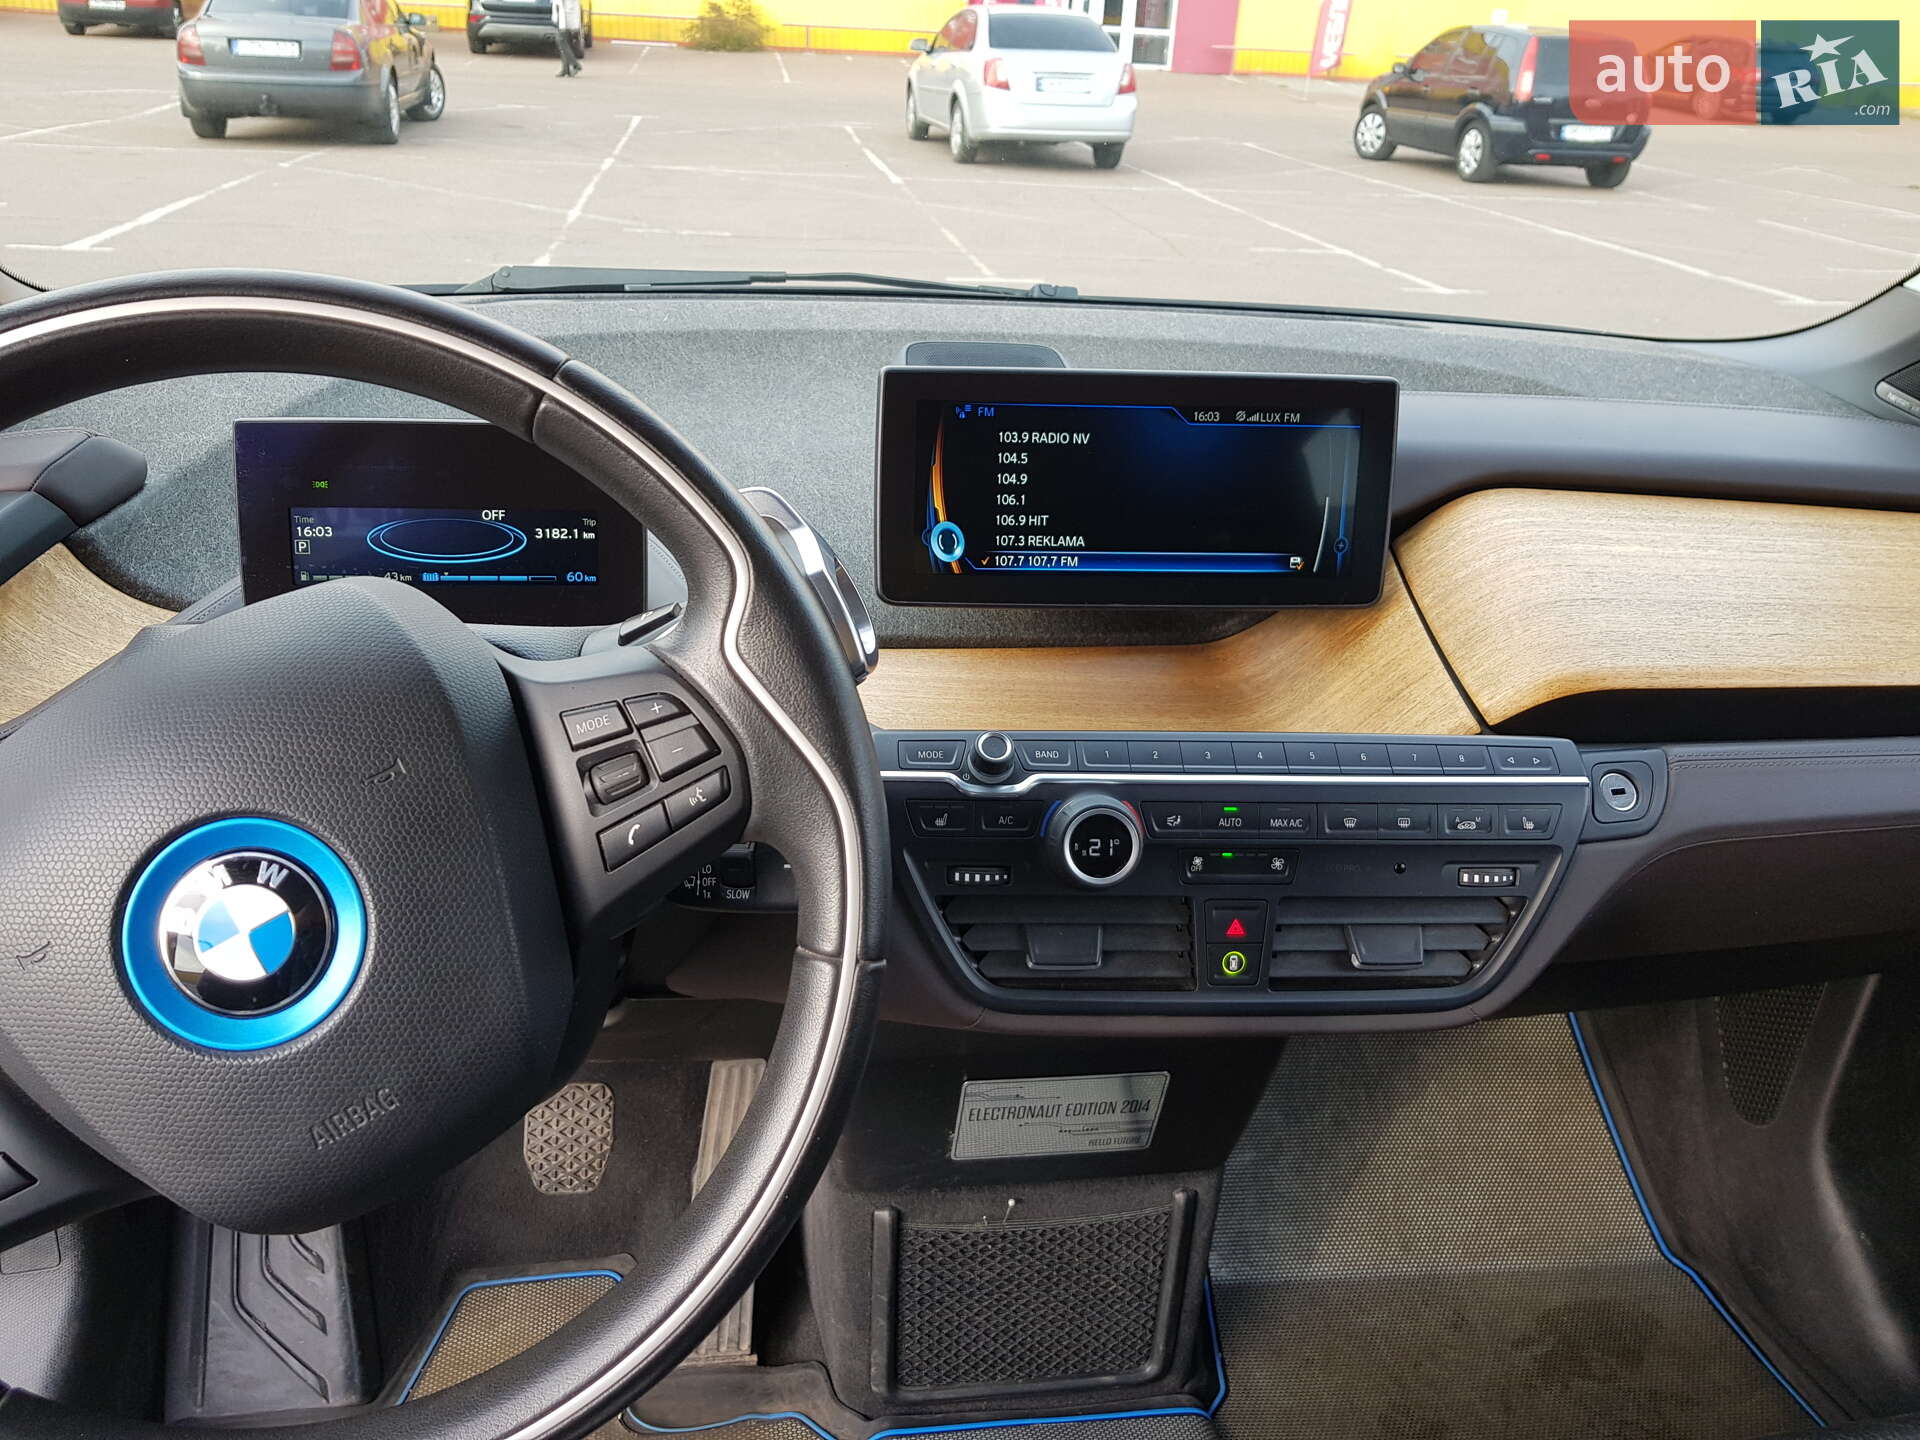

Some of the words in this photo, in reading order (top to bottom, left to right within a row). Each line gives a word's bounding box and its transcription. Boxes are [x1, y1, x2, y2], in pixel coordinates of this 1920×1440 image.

[977, 406, 995, 417] FM
[1193, 411, 1220, 422] 16:03
[1260, 412, 1281, 423] LUX
[1284, 413, 1301, 423] FM
[999, 431, 1029, 444] 103.9
[1031, 432, 1070, 444] RADIO
[1072, 433, 1091, 445] NV
[998, 452, 1028, 464] 104.5
[997, 473, 1028, 485] 104.9
[996, 494, 1026, 506] 106.1
[294, 515, 315, 524] Time
[482, 509, 506, 521] OFF
[996, 514, 1026, 526] 106.9
[1028, 514, 1049, 526] HIT
[582, 518, 597, 527] Trip
[296, 526, 333, 537] 16:03
[535, 528, 579, 539] 3182.1
[583, 531, 596, 540] km
[995, 535, 1025, 547] 107.3
[1027, 535, 1086, 547] REKLAMA
[298, 541, 308, 553] P
[995, 555, 1025, 567] 107.7
[1060, 556, 1079, 567] FM
[400, 574, 413, 582] km
[567, 571, 583, 583] 60
[585, 574, 597, 583] km
[575, 713, 611, 736] MODE
[918, 750, 945, 760] MODE
[1034, 750, 1060, 760] BAND
[1104, 750, 1110, 759] 1
[1151, 750, 1159, 759] 2
[1204, 751, 1212, 760] 3
[1256, 751, 1264, 760] 4
[1308, 751, 1316, 760] 5
[1359, 752, 1368, 761] 6
[1410, 753, 1418, 762] 7
[1458, 753, 1466, 763] 8
[998, 815, 1014, 826] A/C
[1218, 817, 1242, 827] AUTO
[1269, 818, 1288, 828] MAX
[1288, 818, 1304, 828] A/C
[702, 864, 713, 874] LO
[1190, 864, 1203, 873] OFF
[702, 877, 718, 887] OFF
[726, 889, 751, 900] SLOW
[967, 1102, 1063, 1123] ELECTRONAUT
[1064, 1100, 1117, 1118] EDITION
[1119, 1099, 1152, 1115] 2014
[310, 1088, 401, 1150] AIRBAG
